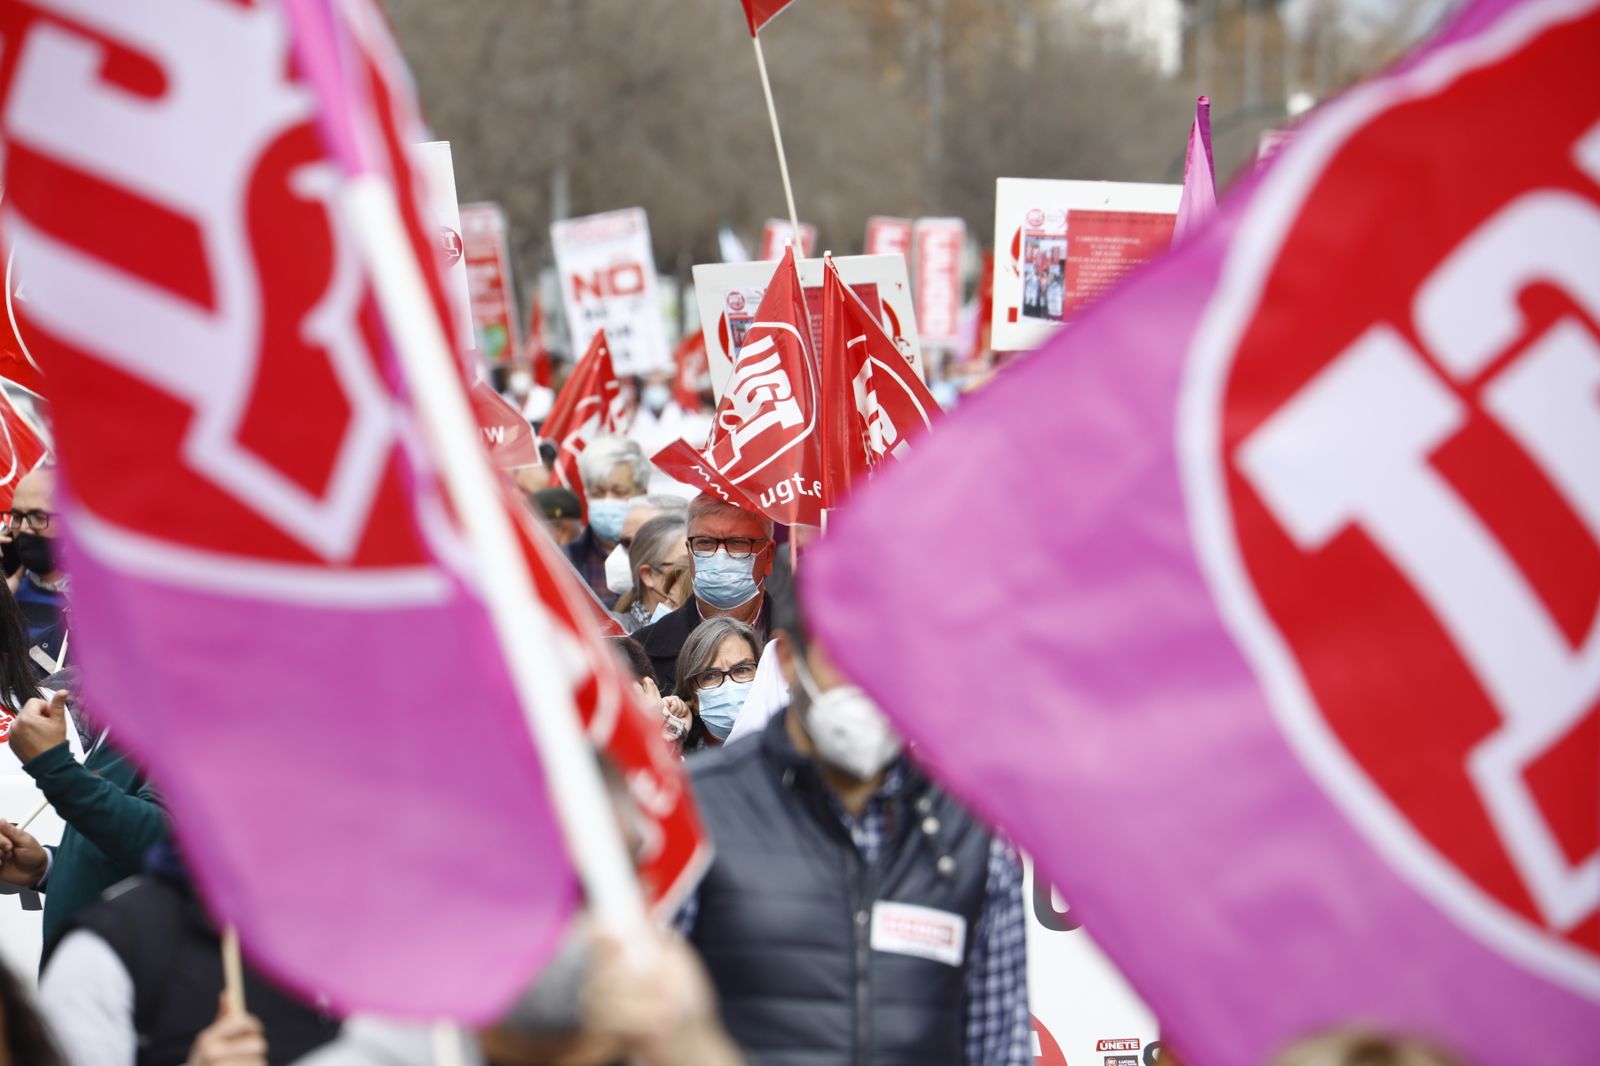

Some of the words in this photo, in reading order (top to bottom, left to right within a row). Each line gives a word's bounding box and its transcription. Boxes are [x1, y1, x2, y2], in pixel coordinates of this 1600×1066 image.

[572, 262, 645, 302] NO
[722, 334, 805, 447] UGT
[760, 472, 822, 508] ugt.e
